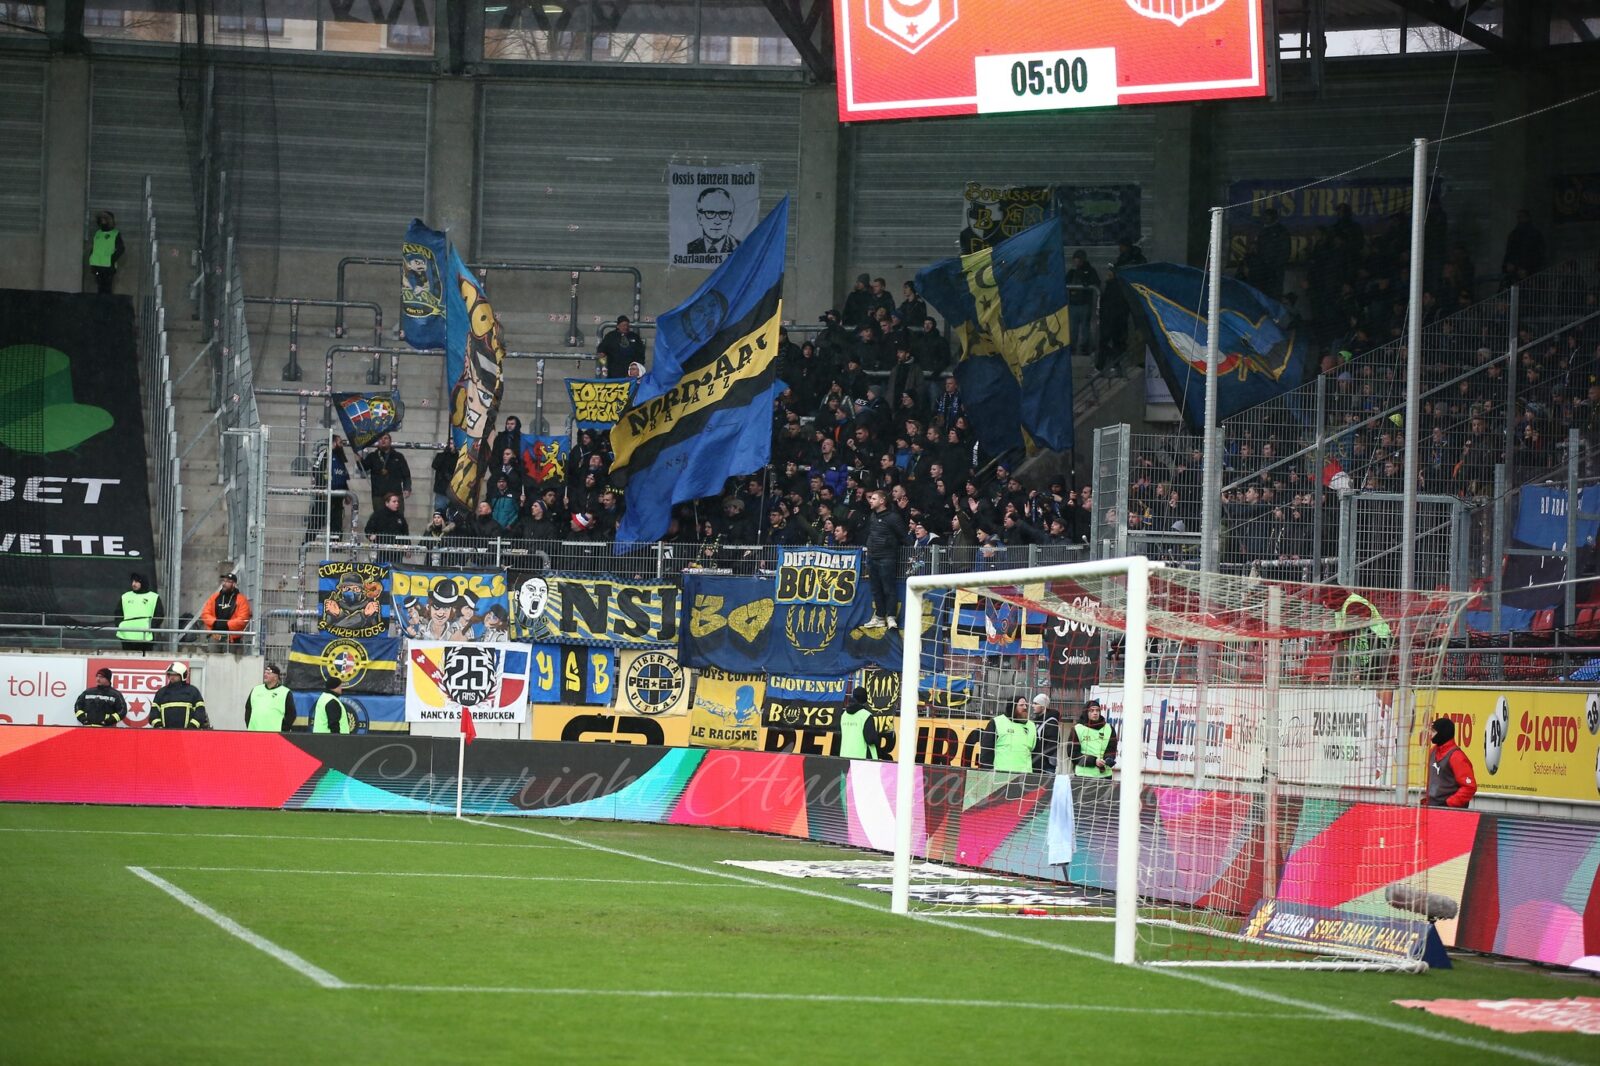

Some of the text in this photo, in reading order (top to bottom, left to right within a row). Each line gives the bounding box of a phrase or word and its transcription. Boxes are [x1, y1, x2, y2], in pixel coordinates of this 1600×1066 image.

[1011, 57, 1088, 97] 05:00
[672, 172, 695, 185] Ossis
[731, 171, 755, 185] nach
[777, 567, 858, 603] BOYS
[8, 672, 67, 698] tolle
[112, 675, 163, 691] HFC
[451, 655, 489, 690] 25
[420, 711, 448, 720] NANCY
[457, 711, 515, 720] SRBRUCKEN
[1313, 712, 1368, 738] ZUSAMMEN
[690, 725, 758, 741] LE RACISME
[1535, 716, 1578, 753] LOTTO
[1533, 761, 1567, 777] Sachsen-Anhalt
[1266, 912, 1315, 938] MERKUR
[1310, 919, 1376, 946] SPIELBANK
